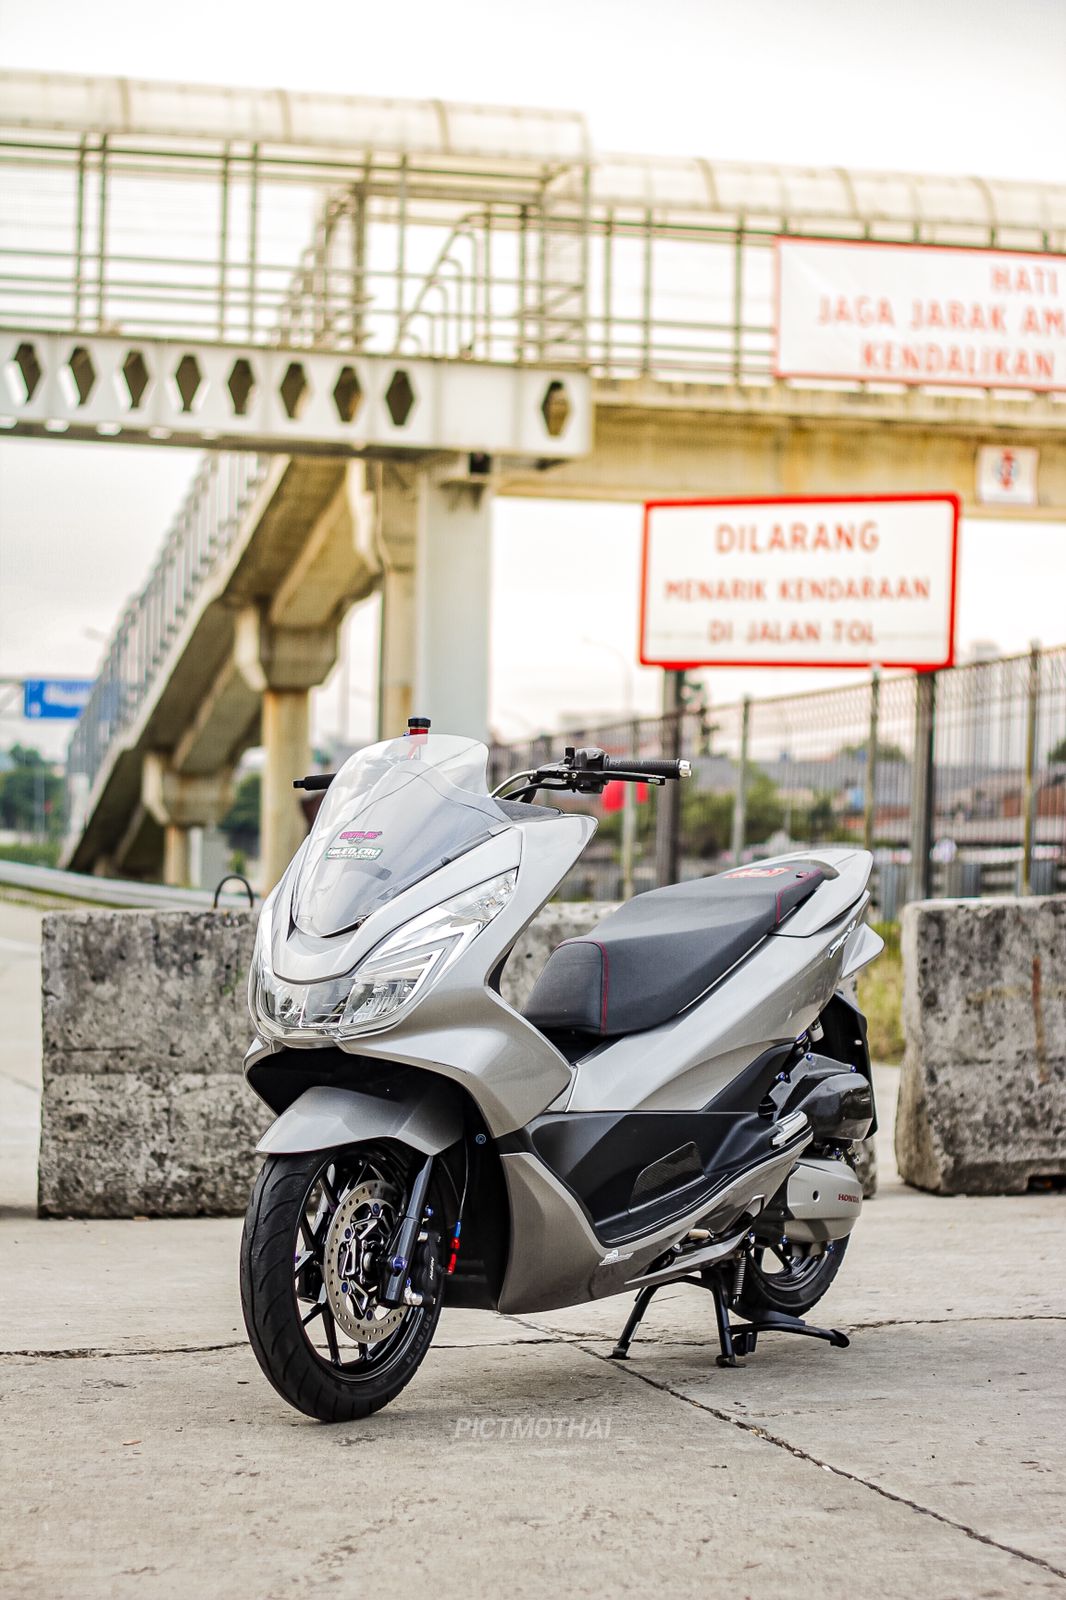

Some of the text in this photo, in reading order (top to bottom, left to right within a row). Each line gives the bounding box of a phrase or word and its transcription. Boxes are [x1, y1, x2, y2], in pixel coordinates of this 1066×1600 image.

[991, 265, 1059, 296] HATI
[817, 294, 896, 328] JAGA
[910, 299, 1007, 335] JARAK
[861, 340, 1056, 379] KENDALIKAN
[714, 520, 880, 554] DILARANG
[664, 575, 931, 603] MENARIK KENDARAAN
[707, 618, 877, 645] DI JALAN TOL
[838, 1193, 859, 1203] HONDA
